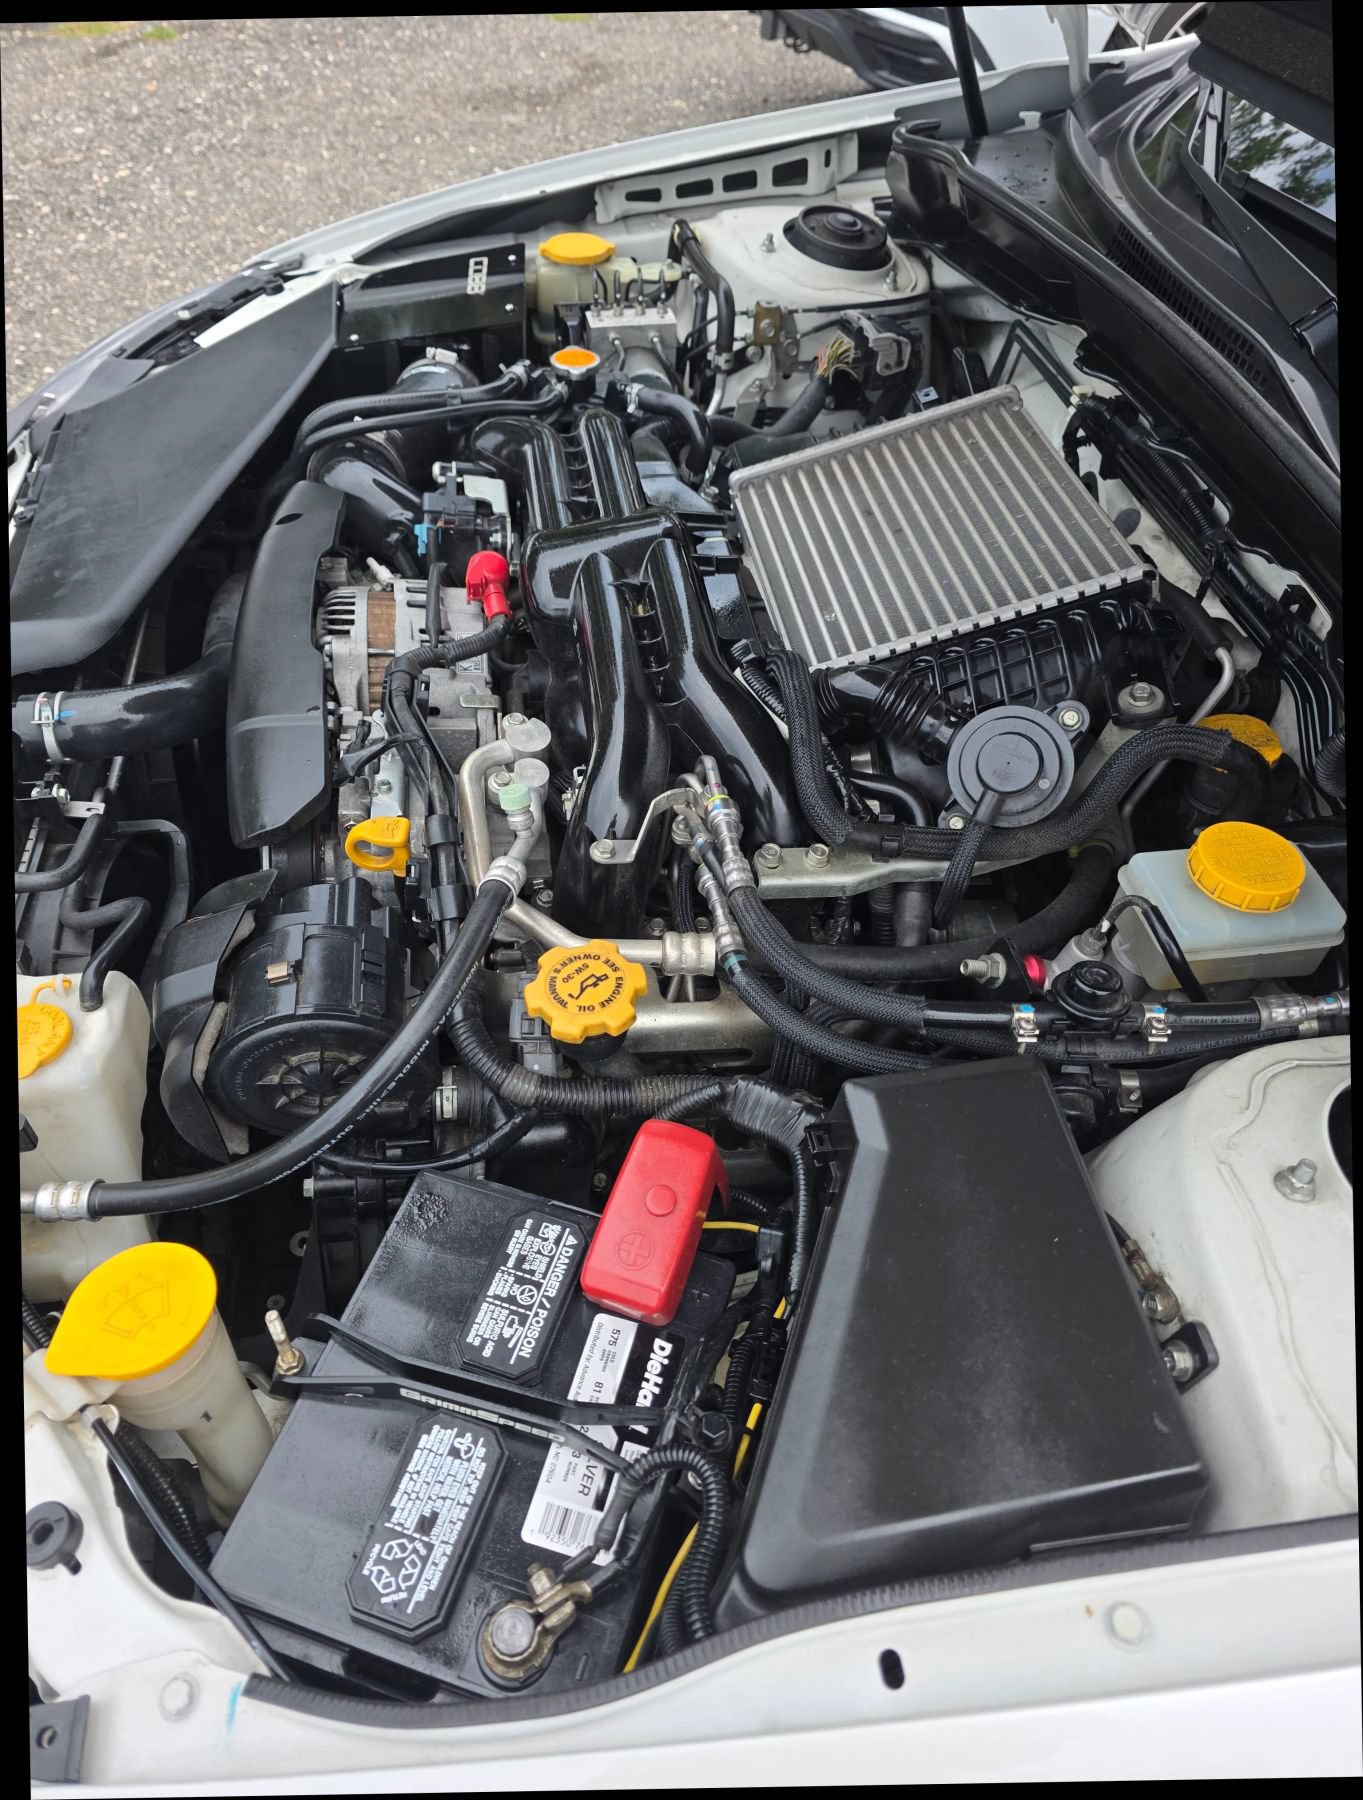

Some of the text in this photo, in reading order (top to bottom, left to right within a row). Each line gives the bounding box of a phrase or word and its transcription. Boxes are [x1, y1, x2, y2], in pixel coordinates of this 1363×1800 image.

[549, 954, 619, 1008] SEE OWNER'S MANUAL
[562, 963, 588, 982] 5W-30
[601, 976, 622, 1008] ENGINE
[521, 1237, 541, 1270] EXPLOSIVE
[529, 1253, 542, 1270] EYES
[534, 1255, 549, 1279] SHIELD
[543, 1245, 573, 1298] DANGER
[508, 1283, 520, 1296] NO
[472, 1335, 481, 1346] OR
[481, 1307, 509, 1358] SULFURIC ACID
[518, 1307, 548, 1358] POISON
[587, 1322, 604, 1354] Distributed
[607, 1328, 620, 1347] 575
[584, 1354, 592, 1364] by:
[576, 1364, 589, 1390] Advance
[592, 1380, 603, 1393] 81
[447, 1457, 461, 1476] WITH
[552, 1451, 559, 1461] NC
[421, 1454, 453, 1517] MEDICAL HELP FAST
[429, 1459, 469, 1541] FLUSH EYES IMMEDIATELY
[432, 1497, 444, 1512] GET
[449, 1503, 462, 1522] VENT
[428, 1461, 487, 1591] KEEP OUT OF THE REACH OF CHILDREN
[361, 1542, 380, 1575] RECYCLE
[432, 1542, 446, 1563] TIGHT
[424, 1564, 436, 1581] AND
[415, 1580, 430, 1603] LEVEL
